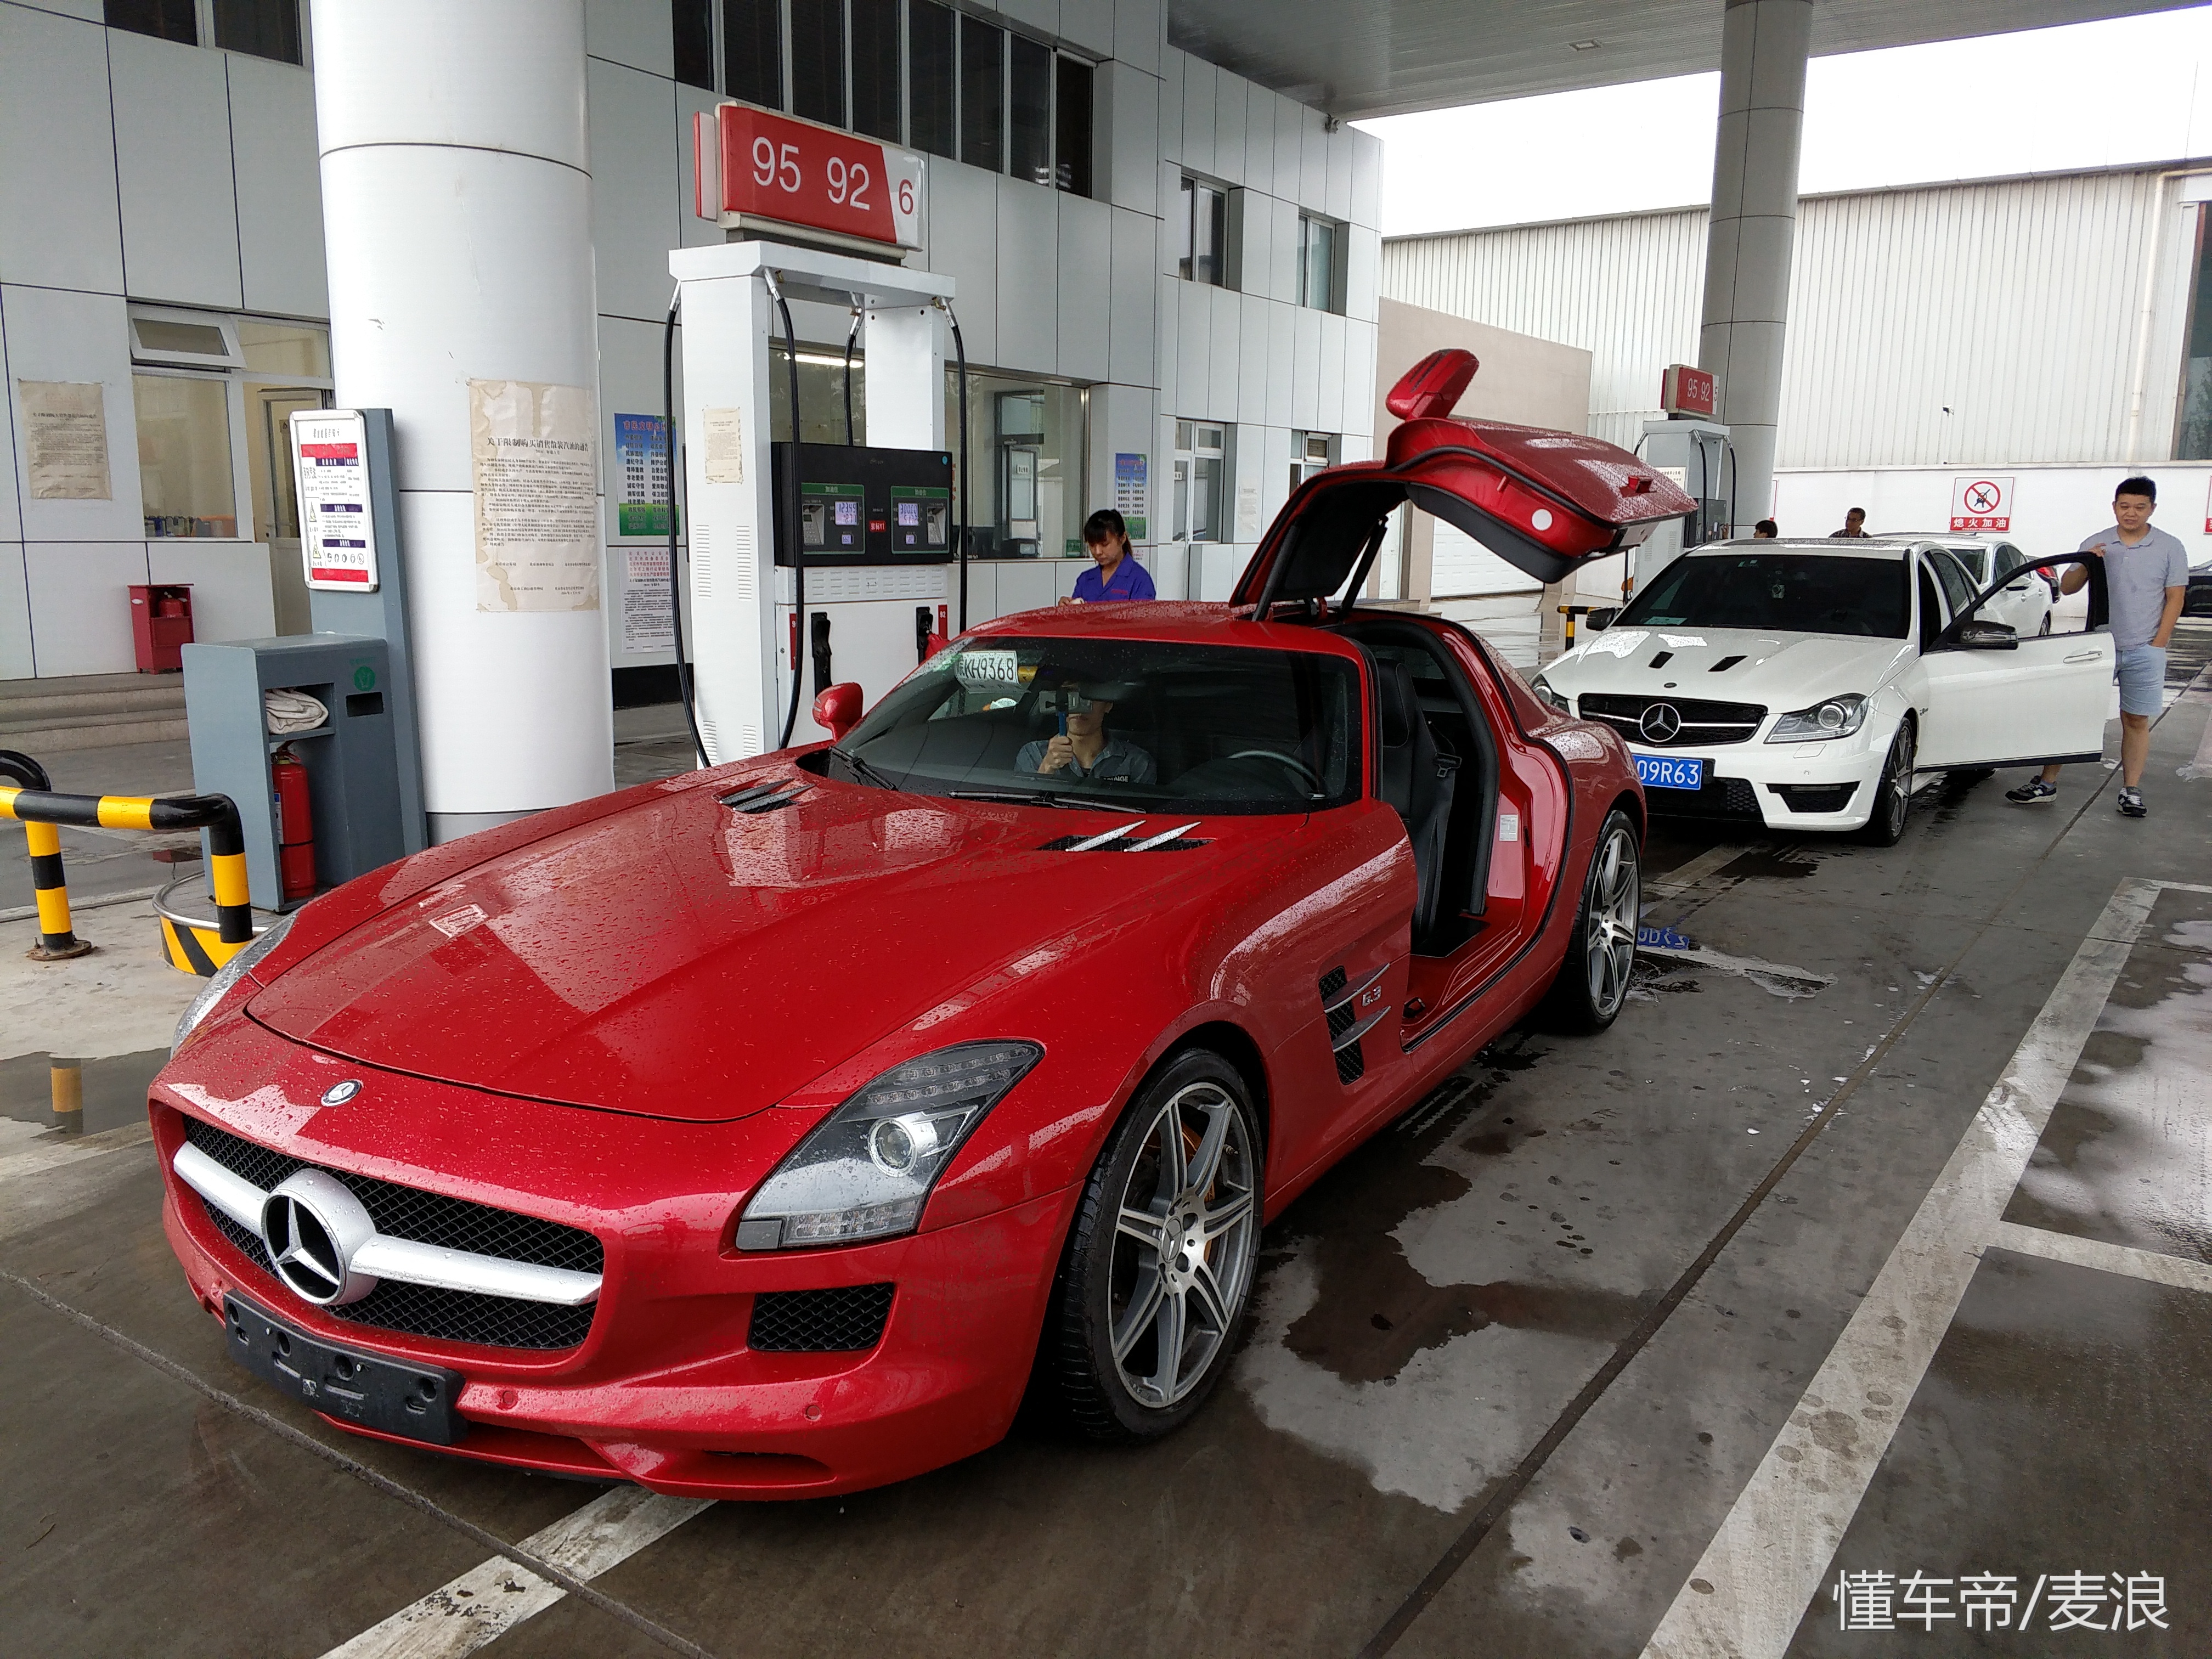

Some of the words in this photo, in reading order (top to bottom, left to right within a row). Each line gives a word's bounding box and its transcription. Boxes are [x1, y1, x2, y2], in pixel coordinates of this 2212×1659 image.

[752, 137, 801, 193] 95
[826, 156, 870, 211] 92
[899, 179, 913, 215] 6
[1687, 377, 1698, 399] 95
[1701, 381, 1711, 402] 92
[487, 437, 589, 452] 关于限制购买销售散装汽油的通告
[1954, 518, 2007, 528] 熄火加油
[1637, 760, 1699, 785] 09R63
[1362, 985, 1381, 1007] 6.3
